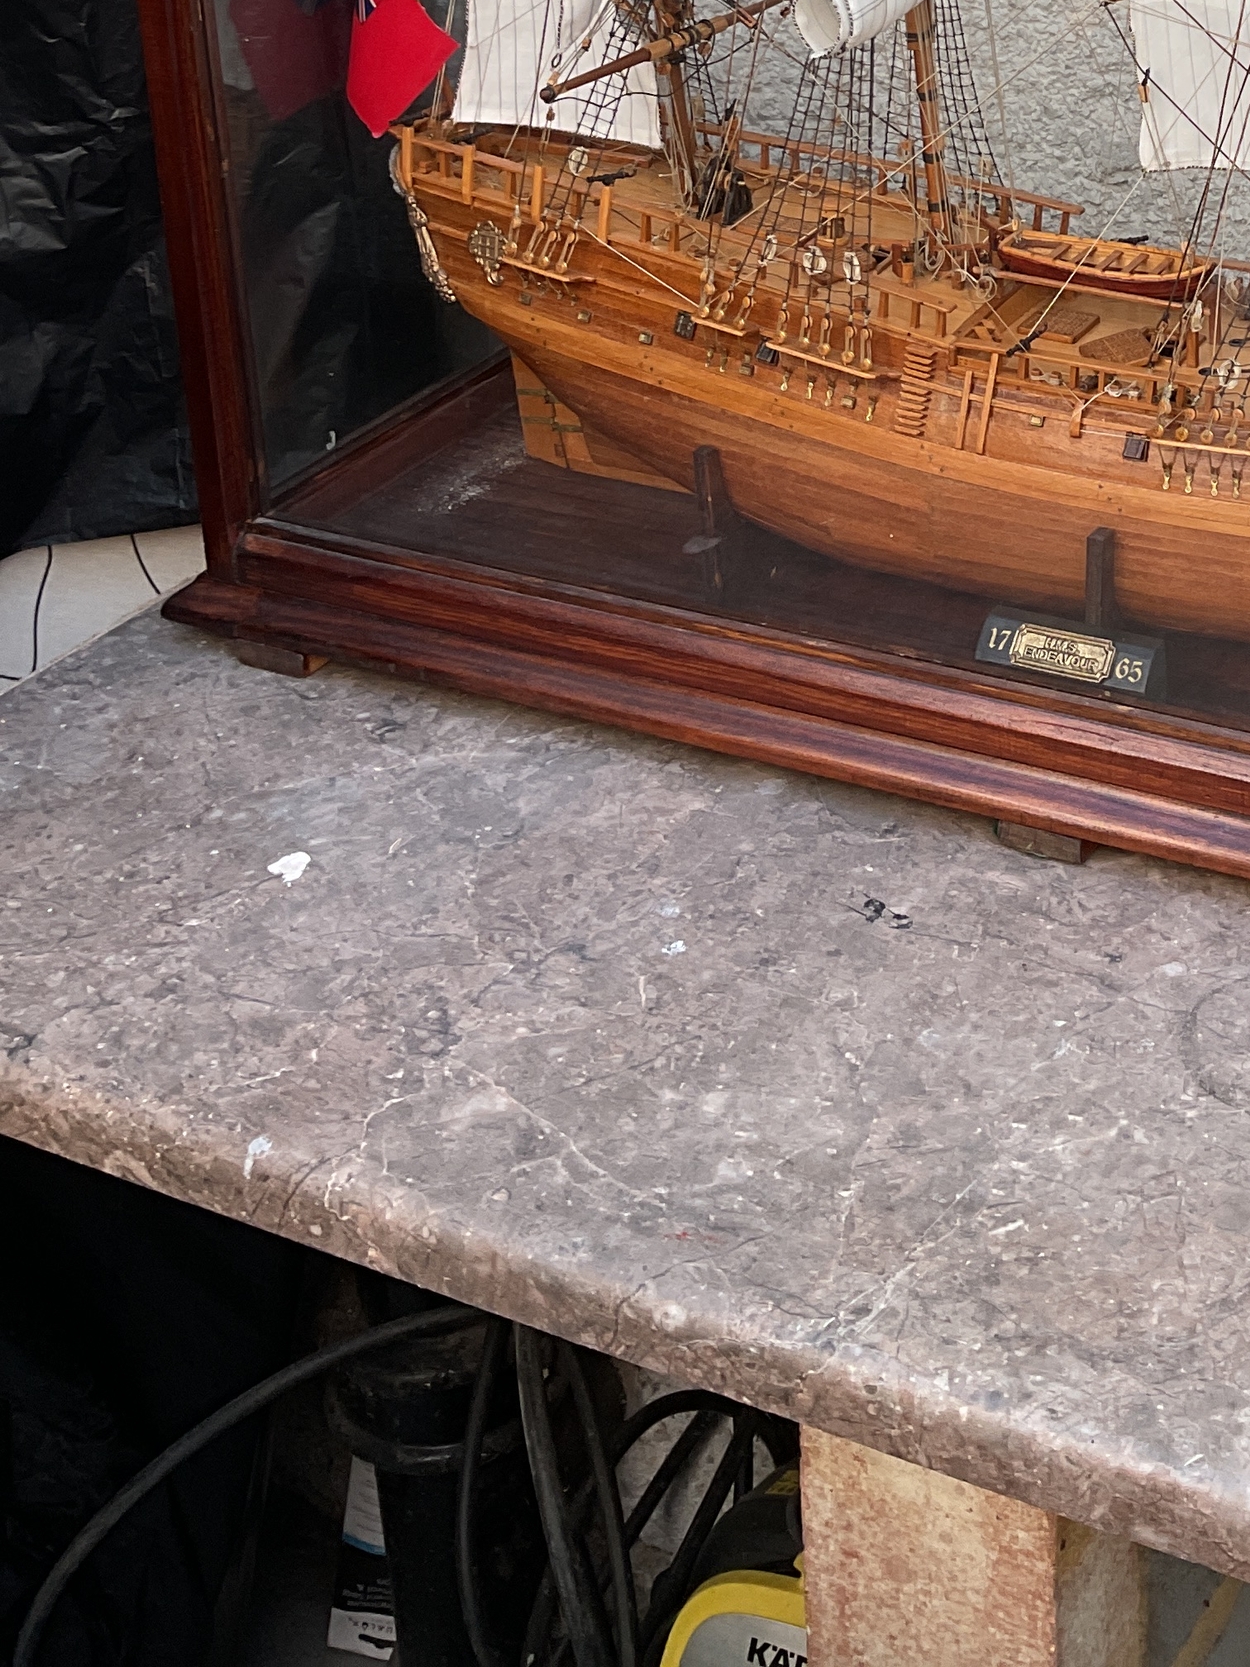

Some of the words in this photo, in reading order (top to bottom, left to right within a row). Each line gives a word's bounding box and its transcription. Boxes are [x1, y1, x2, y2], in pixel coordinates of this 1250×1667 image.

[988, 627, 1012, 651] 17
[1023, 646, 1099, 672] ENDEAVOUR
[1115, 658, 1143, 683] 65
